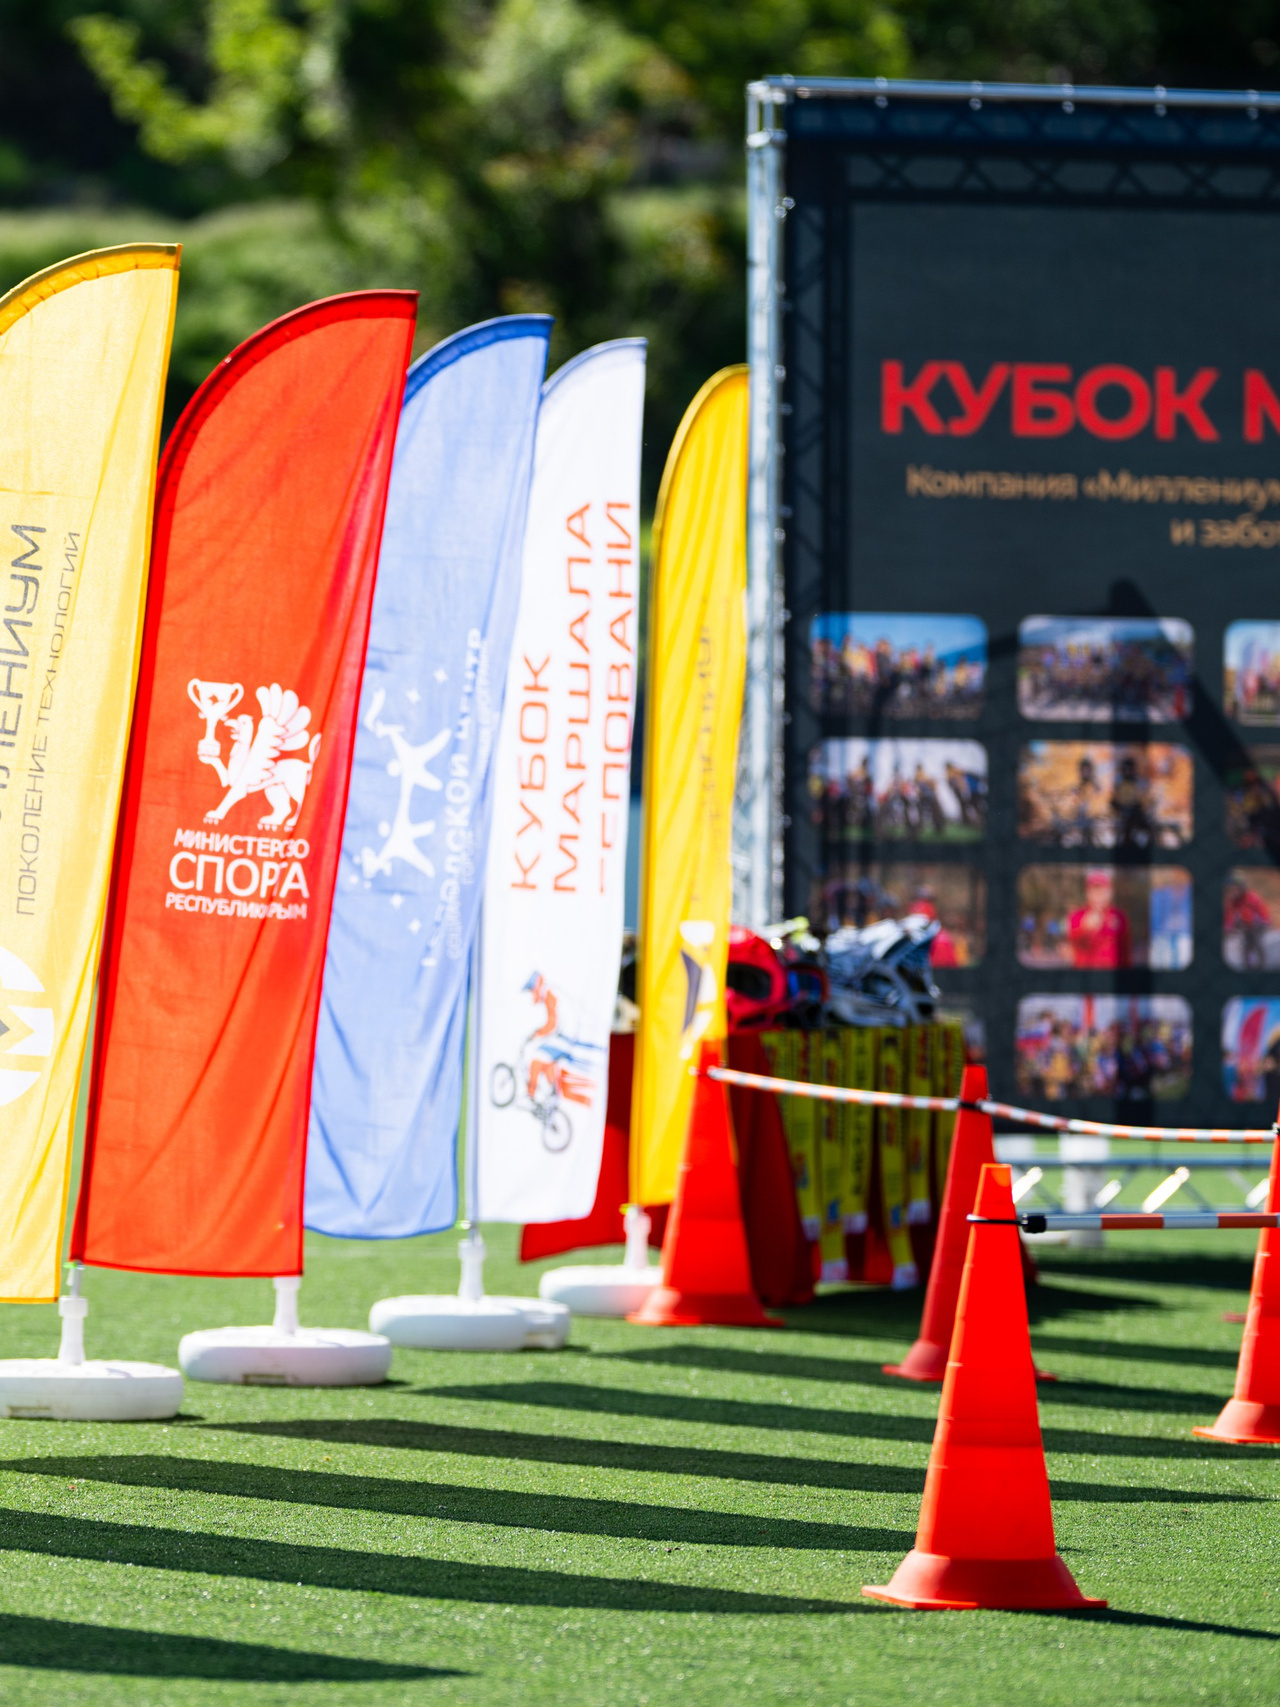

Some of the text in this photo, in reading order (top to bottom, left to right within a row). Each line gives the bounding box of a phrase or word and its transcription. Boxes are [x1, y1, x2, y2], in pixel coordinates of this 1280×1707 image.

[882, 360, 1219, 443] КУБОК
[905, 464, 1078, 500] Компания
[1199, 511, 1280, 549] забо
[16, 531, 81, 916] ПОКОЛЕНИЕ ТЕХНОЛОГИЙ
[510, 654, 551, 891] КУБОК
[553, 502, 592, 892] МАРШАЛА
[599, 502, 633, 895] ЛОВАНИ
[173, 828, 310, 860] МИНИСТЕРО
